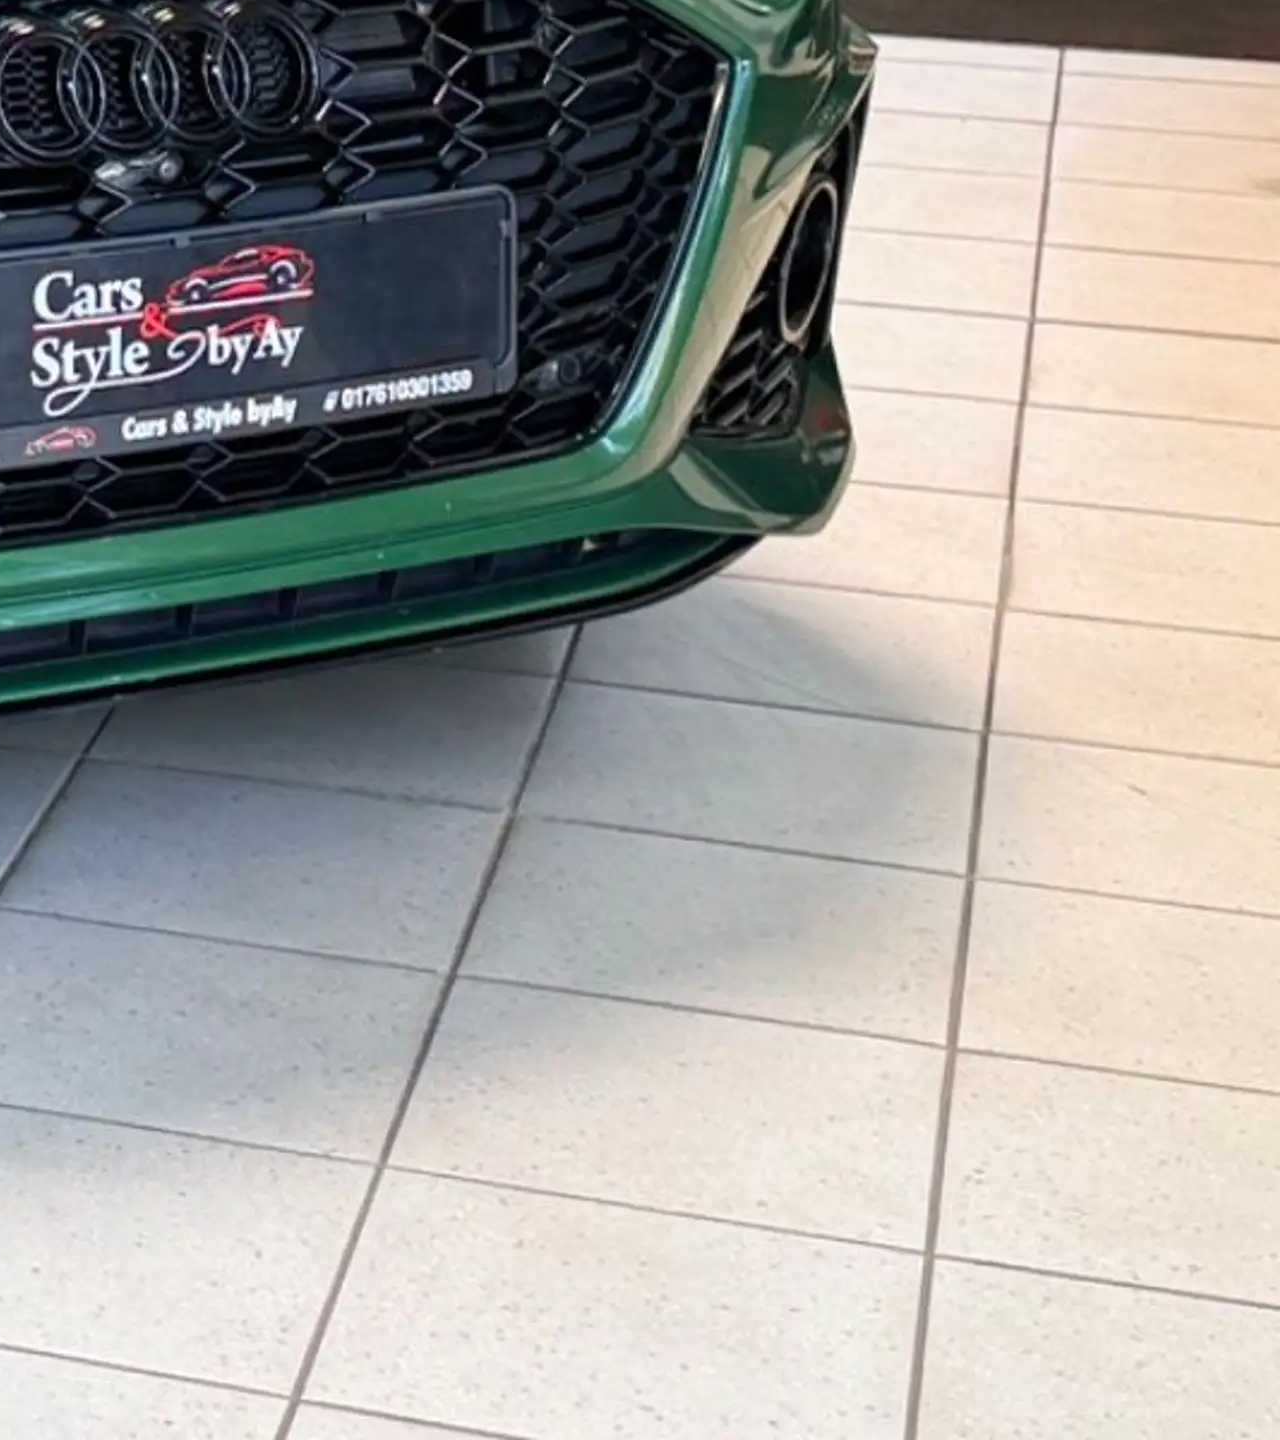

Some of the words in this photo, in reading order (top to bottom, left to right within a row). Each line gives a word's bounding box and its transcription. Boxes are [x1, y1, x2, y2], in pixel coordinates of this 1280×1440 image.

[32, 270, 143, 322] Cars
[140, 302, 176, 339] &
[30, 326, 150, 417] Style
[121, 415, 167, 441] Cars
[172, 410, 189, 435] &
[193, 402, 240, 435] Style
